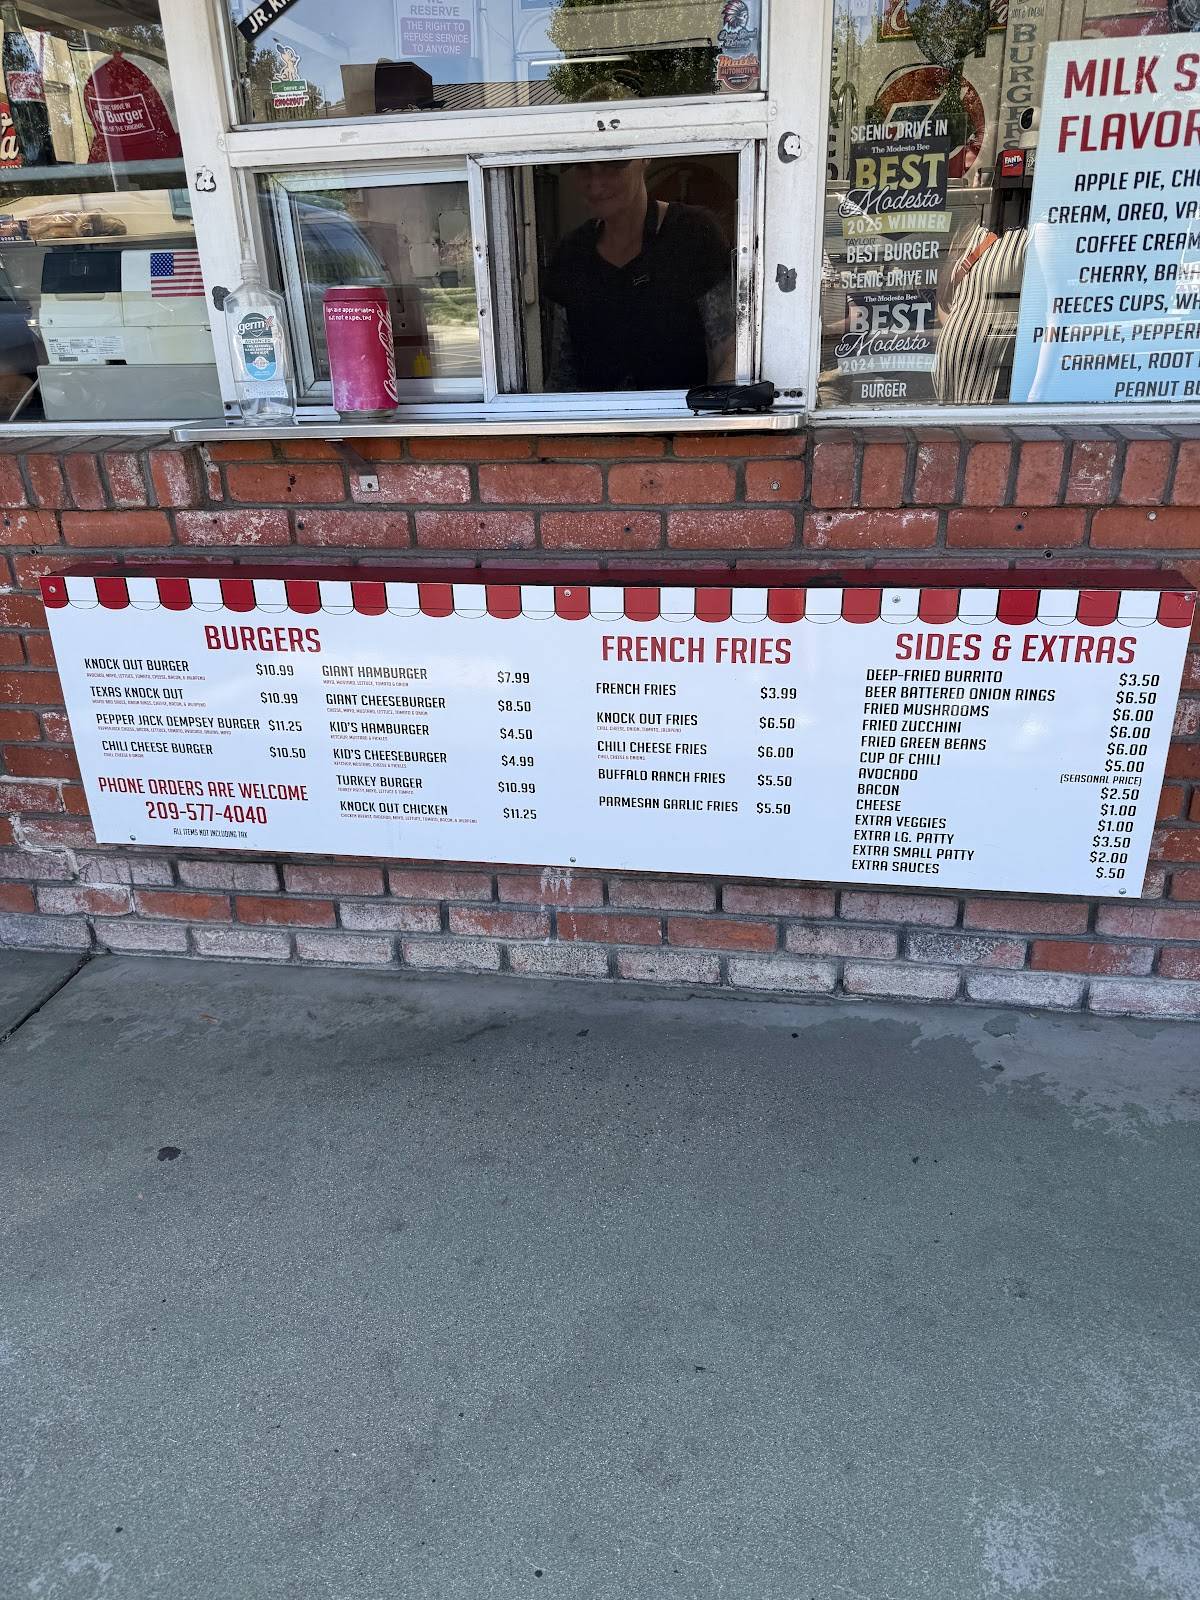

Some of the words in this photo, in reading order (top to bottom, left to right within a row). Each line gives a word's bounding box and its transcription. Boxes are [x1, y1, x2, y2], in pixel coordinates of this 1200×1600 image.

[410, 5, 460, 17] RESERVE
[248, 8, 273, 34] JR.
[407, 20, 423, 30] THE
[425, 21, 451, 31] RIGHT
[453, 22, 465, 31] TO
[403, 32, 434, 42] REFUSE
[436, 33, 469, 44] SERVICE
[413, 43, 424, 53] TO
[425, 44, 461, 55] ANYONE
[1064, 55, 1160, 98] MILK
[106, 109, 143, 124] Burger
[851, 122, 893, 143] SCENIC
[896, 120, 932, 140] DRIVE
[935, 119, 948, 136] IN
[871, 146, 886, 154] The
[886, 145, 916, 153] Modesto
[1004, 155, 1023, 165] FANTA
[855, 153, 946, 191] BEST
[1074, 171, 1129, 192] APPLE
[1133, 170, 1165, 191] PIE,
[846, 186, 943, 214] Modesto
[1048, 204, 1111, 224] CREAM,
[1117, 202, 1168, 222] OREO,
[847, 216, 883, 235] 2025
[887, 213, 946, 230] WINNER
[1075, 234, 1138, 254] COFFEE
[846, 244, 881, 264] BEST
[883, 240, 940, 262] BURGER
[1079, 264, 1148, 284] CHERRY,
[1052, 295, 1114, 314] REECES
[1119, 294, 1169, 313] CUPS,
[850, 302, 932, 335] BEST
[1033, 325, 1126, 345] PINEAPPLE,
[838, 330, 930, 357] Modesto
[842, 358, 877, 373] 2024
[1061, 353, 1142, 371] CARAMEL,
[1148, 352, 1195, 369] ROOT
[861, 382, 907, 399] BURGER
[1114, 380, 1180, 398] PEANUT
[204, 625, 321, 653] BURGERS
[602, 635, 705, 663] FRENCH
[716, 637, 792, 665] FRIES
[895, 633, 982, 661] SIDES
[992, 634, 1012, 661] &
[1021, 634, 1137, 664] EXTRAS
[84, 658, 121, 670] KNOCK
[122, 659, 144, 671] OUT
[146, 660, 190, 672] BURGER
[255, 664, 294, 677] $10.99
[322, 665, 354, 678] GIANT
[357, 666, 428, 680] HAMBURGER
[497, 671, 530, 684] $7.99
[866, 668, 941, 682] DEEP-FRIED
[944, 670, 1003, 684] BURRITO
[1119, 673, 1160, 687] $3.50
[90, 686, 122, 698] TEXAS
[125, 687, 161, 699] KNOCK
[162, 688, 184, 700] OUT
[596, 682, 641, 695] FRENCH
[644, 683, 677, 696] FRIES
[760, 686, 797, 700] $3.99
[865, 686, 898, 699] BEER
[900, 686, 966, 700] BATTERED
[969, 688, 1012, 701] ONION
[1015, 689, 1056, 702] RINGS
[261, 692, 299, 705] $10.99
[325, 693, 358, 706] GIANT
[361, 694, 446, 709] CHEESEBURGER
[1116, 690, 1157, 705] $6.50
[498, 699, 532, 713] $8.50
[863, 702, 899, 716] FRIED
[903, 703, 990, 718] MUSHROOMS
[96, 713, 135, 725] PEPPER
[138, 715, 164, 727] JACK
[166, 716, 214, 728] DEMPSEY
[217, 717, 261, 730] BURGER
[597, 712, 636, 724] KNOCK
[639, 713, 663, 725] OUT
[666, 713, 698, 726] FRIES
[759, 716, 796, 729] $6.50
[1112, 708, 1154, 722] $6.00
[268, 719, 303, 732] $11.25
[329, 721, 358, 733] KID'S
[361, 722, 430, 736] HAMBURGER
[862, 719, 898, 732] FRIED
[901, 720, 962, 733] ZUCCHINI
[1110, 725, 1151, 739] $6.00
[500, 727, 533, 740] $4.50
[101, 740, 129, 752] CHILI
[131, 741, 169, 753] CHEESE
[171, 743, 214, 755] BURGER
[597, 740, 626, 753] CHILI
[629, 741, 672, 754] CHEESE
[675, 743, 708, 755] FRIES
[861, 735, 896, 748] FRIED
[900, 736, 940, 750] GREEN
[944, 738, 987, 751] BEANS
[1106, 742, 1148, 757] $6.00
[270, 746, 306, 759] $10.50
[333, 748, 361, 760] KID'S
[364, 749, 447, 764] CHEESEBURGER
[757, 746, 794, 759] $6.00
[860, 751, 886, 764] CUP
[889, 752, 905, 764] OF
[908, 753, 942, 766] CHILI
[501, 755, 534, 768] $4.99
[1104, 759, 1145, 773] $5.00
[336, 774, 377, 787] TURKEY
[380, 776, 423, 789] BURGER
[598, 768, 648, 781] BUFFALO
[651, 770, 690, 783] RANCH
[694, 772, 726, 784] FRIES
[757, 774, 793, 787] $5.50
[858, 767, 918, 781] AVOCADO
[1060, 773, 1110, 785] (SEASONAL
[1113, 775, 1142, 787] PRICE)
[98, 776, 145, 794] PHONE
[148, 778, 204, 797] ORDERS
[208, 781, 236, 798] ARE
[238, 783, 309, 801] WELCOME
[498, 781, 536, 794] $10.99
[857, 783, 900, 796] BACON
[1100, 787, 1140, 801] $2.50
[339, 800, 376, 813] KNOCK
[379, 801, 400, 814] OUT
[402, 803, 448, 816] CHICKEN
[599, 795, 660, 809] PARMESAN
[663, 798, 703, 811] GARLIC
[707, 800, 739, 812] FRIES
[756, 802, 791, 815] $5.50
[856, 798, 902, 812] CHEESE
[1100, 803, 1137, 817] $1.00
[145, 801, 268, 824] 209-577-4040
[503, 807, 537, 820] $11.25
[855, 813, 892, 827] EXTRA
[896, 815, 947, 829] VEGGIES
[1097, 819, 1134, 833] $1.00
[853, 829, 891, 842] EXTRA
[894, 831, 912, 843] LG.
[916, 832, 954, 845] PATTY
[1092, 835, 1131, 849] $3.50
[852, 844, 890, 857] EXTRA
[893, 846, 933, 859] SMALL
[936, 848, 975, 861] PATTY
[1089, 850, 1128, 864] $2.00
[851, 859, 889, 872] EXTRA
[891, 860, 940, 874] SAUCES
[1095, 866, 1125, 880] $.50
